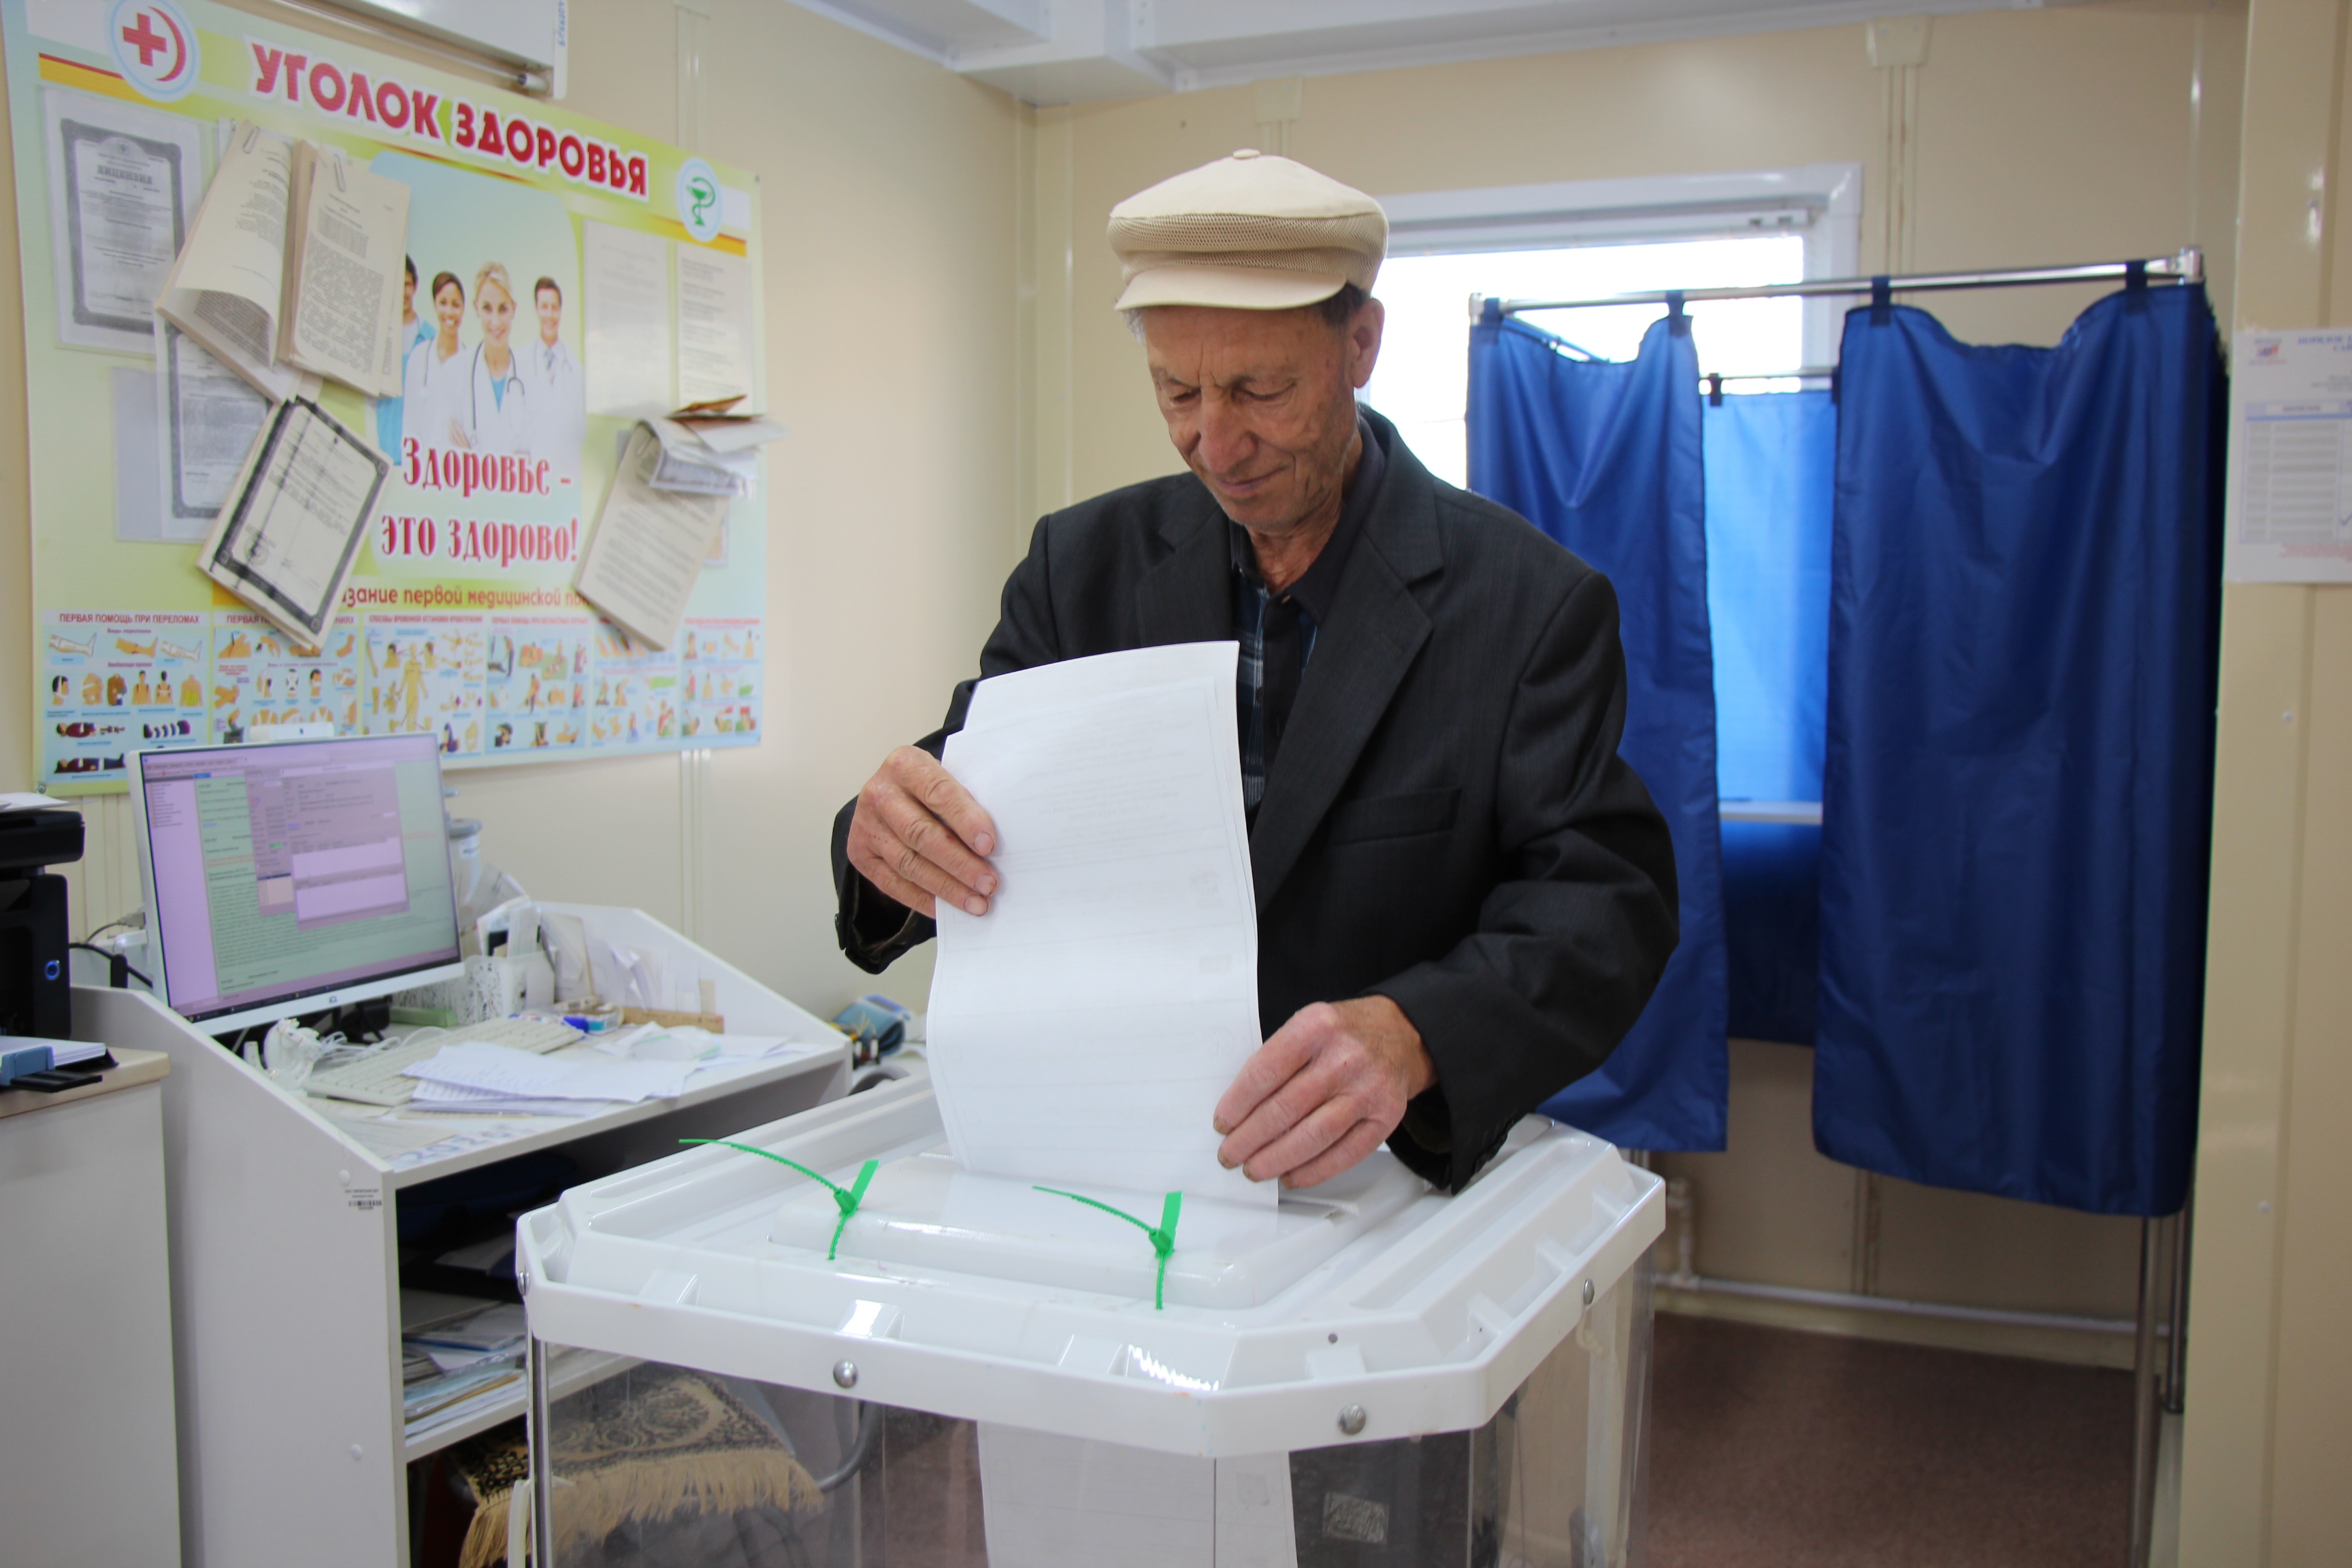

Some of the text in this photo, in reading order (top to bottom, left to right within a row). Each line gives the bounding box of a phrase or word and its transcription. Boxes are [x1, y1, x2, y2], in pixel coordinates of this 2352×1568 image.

[252, 43, 647, 196] УГОЛОК ЗДОРОВЬЯ
[404, 437, 551, 497] Здоровье
[382, 515, 578, 568] это здорово!
[404, 584, 463, 607] первой
[468, 586, 561, 609] медицинской
[59, 613, 199, 623] ПЕРВАЯ ПОМОЩЬ ПРИ ПЕРЕЛОМАХ
[227, 615, 260, 623] ПЕРВАЯ
